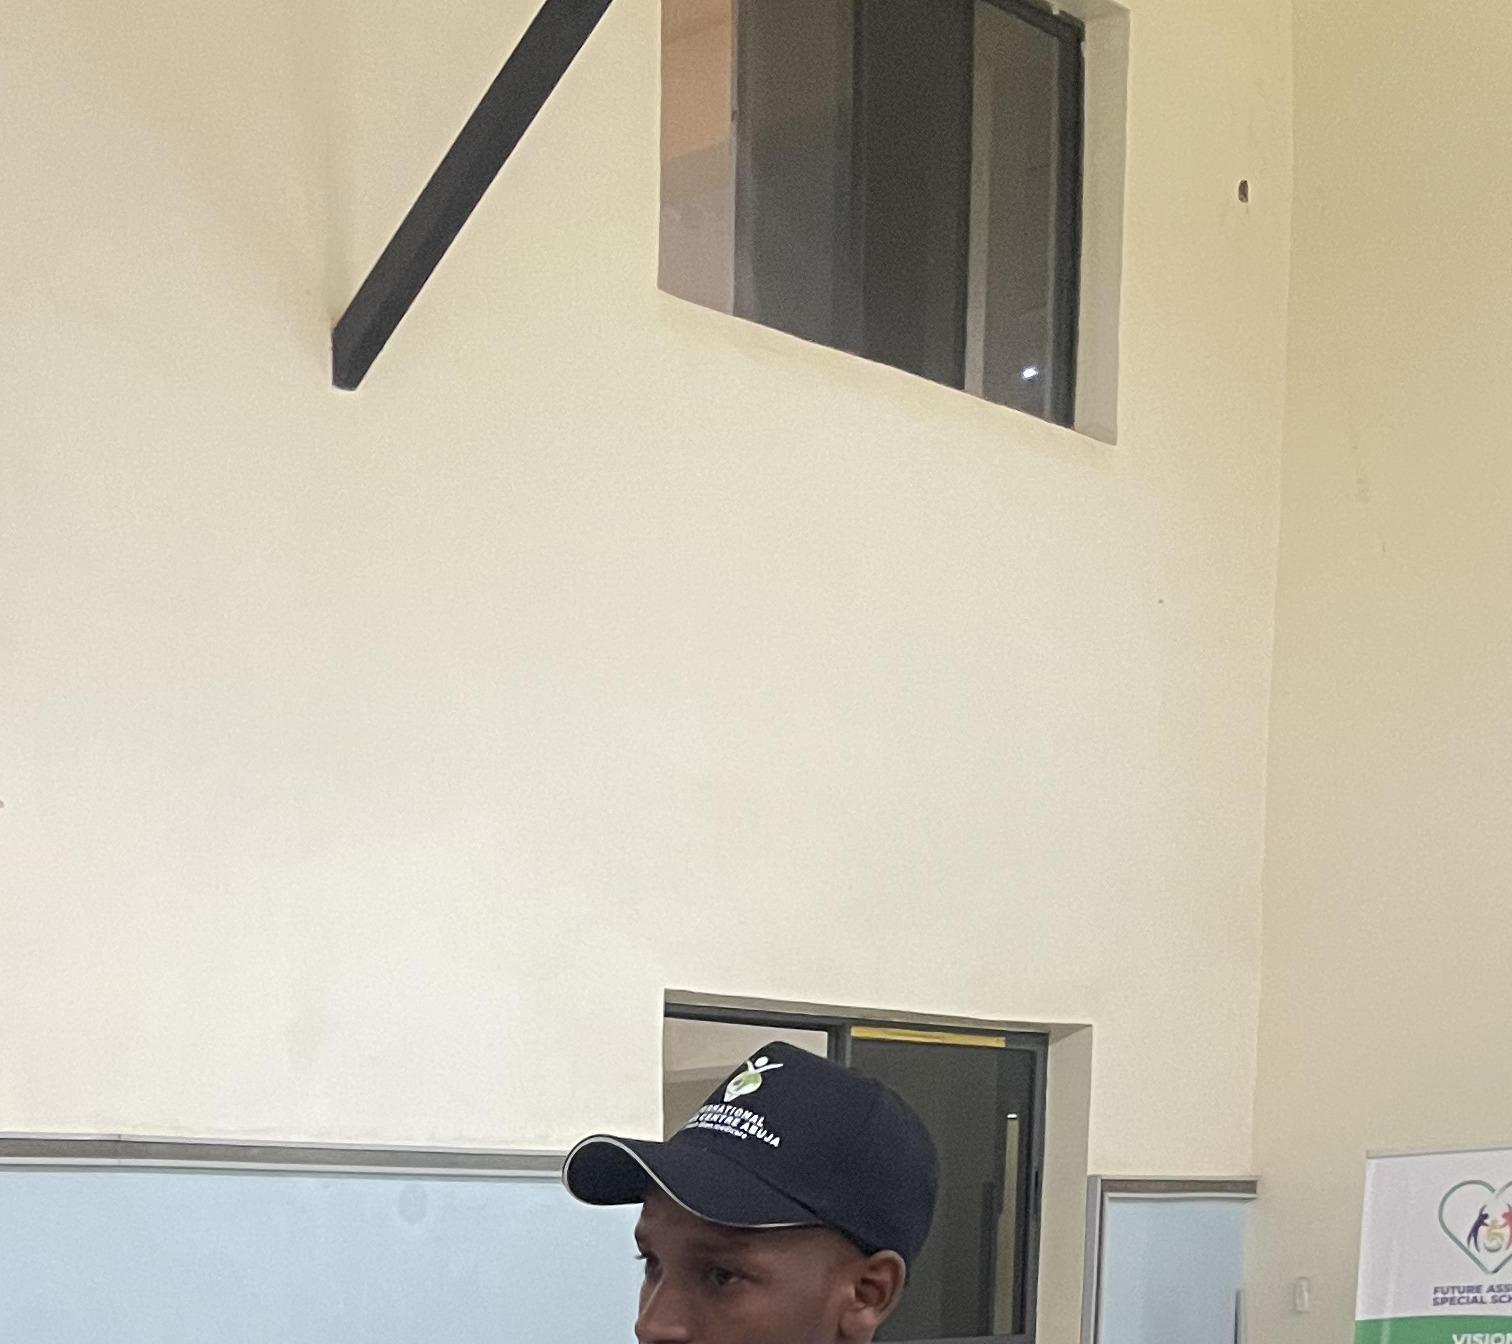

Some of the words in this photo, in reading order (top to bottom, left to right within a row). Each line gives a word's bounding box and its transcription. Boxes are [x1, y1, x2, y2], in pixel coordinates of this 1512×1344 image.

[740, 1122, 781, 1148] ABUJA
[1433, 1285, 1483, 1295] FUTURE
[1432, 1295, 1487, 1306] SPECIAL
